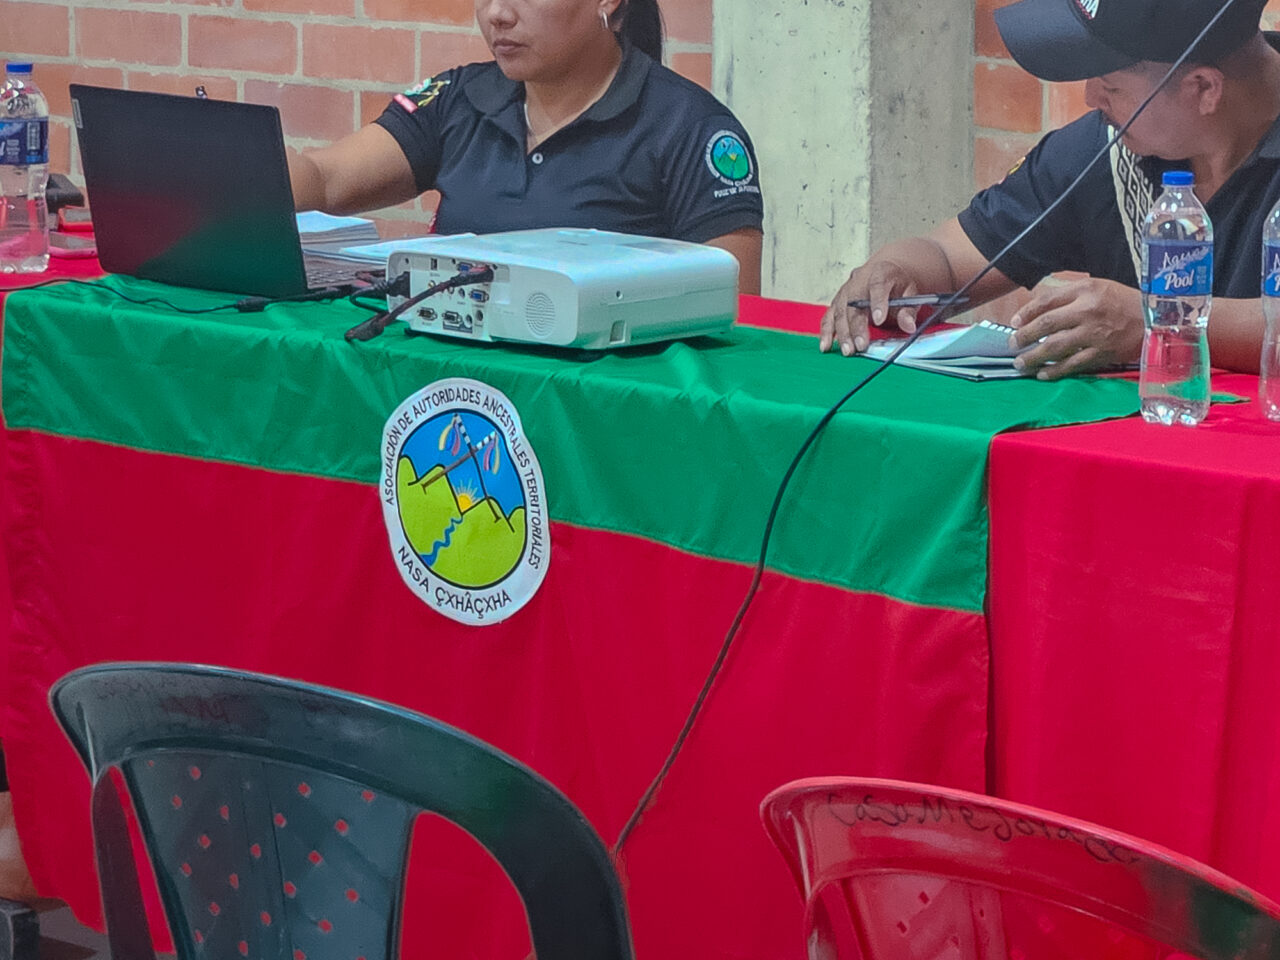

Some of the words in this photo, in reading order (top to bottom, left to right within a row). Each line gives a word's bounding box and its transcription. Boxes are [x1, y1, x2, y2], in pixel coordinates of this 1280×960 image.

[1164, 268, 1195, 291] Pool
[384, 430, 402, 506] ASOCIACIÓN
[397, 415, 413, 433] DE
[412, 388, 481, 417] AUTORIDADES
[482, 395, 531, 469] ANCESTRALES
[524, 468, 545, 570] TERRITORIALES
[397, 546, 431, 593] NASA
